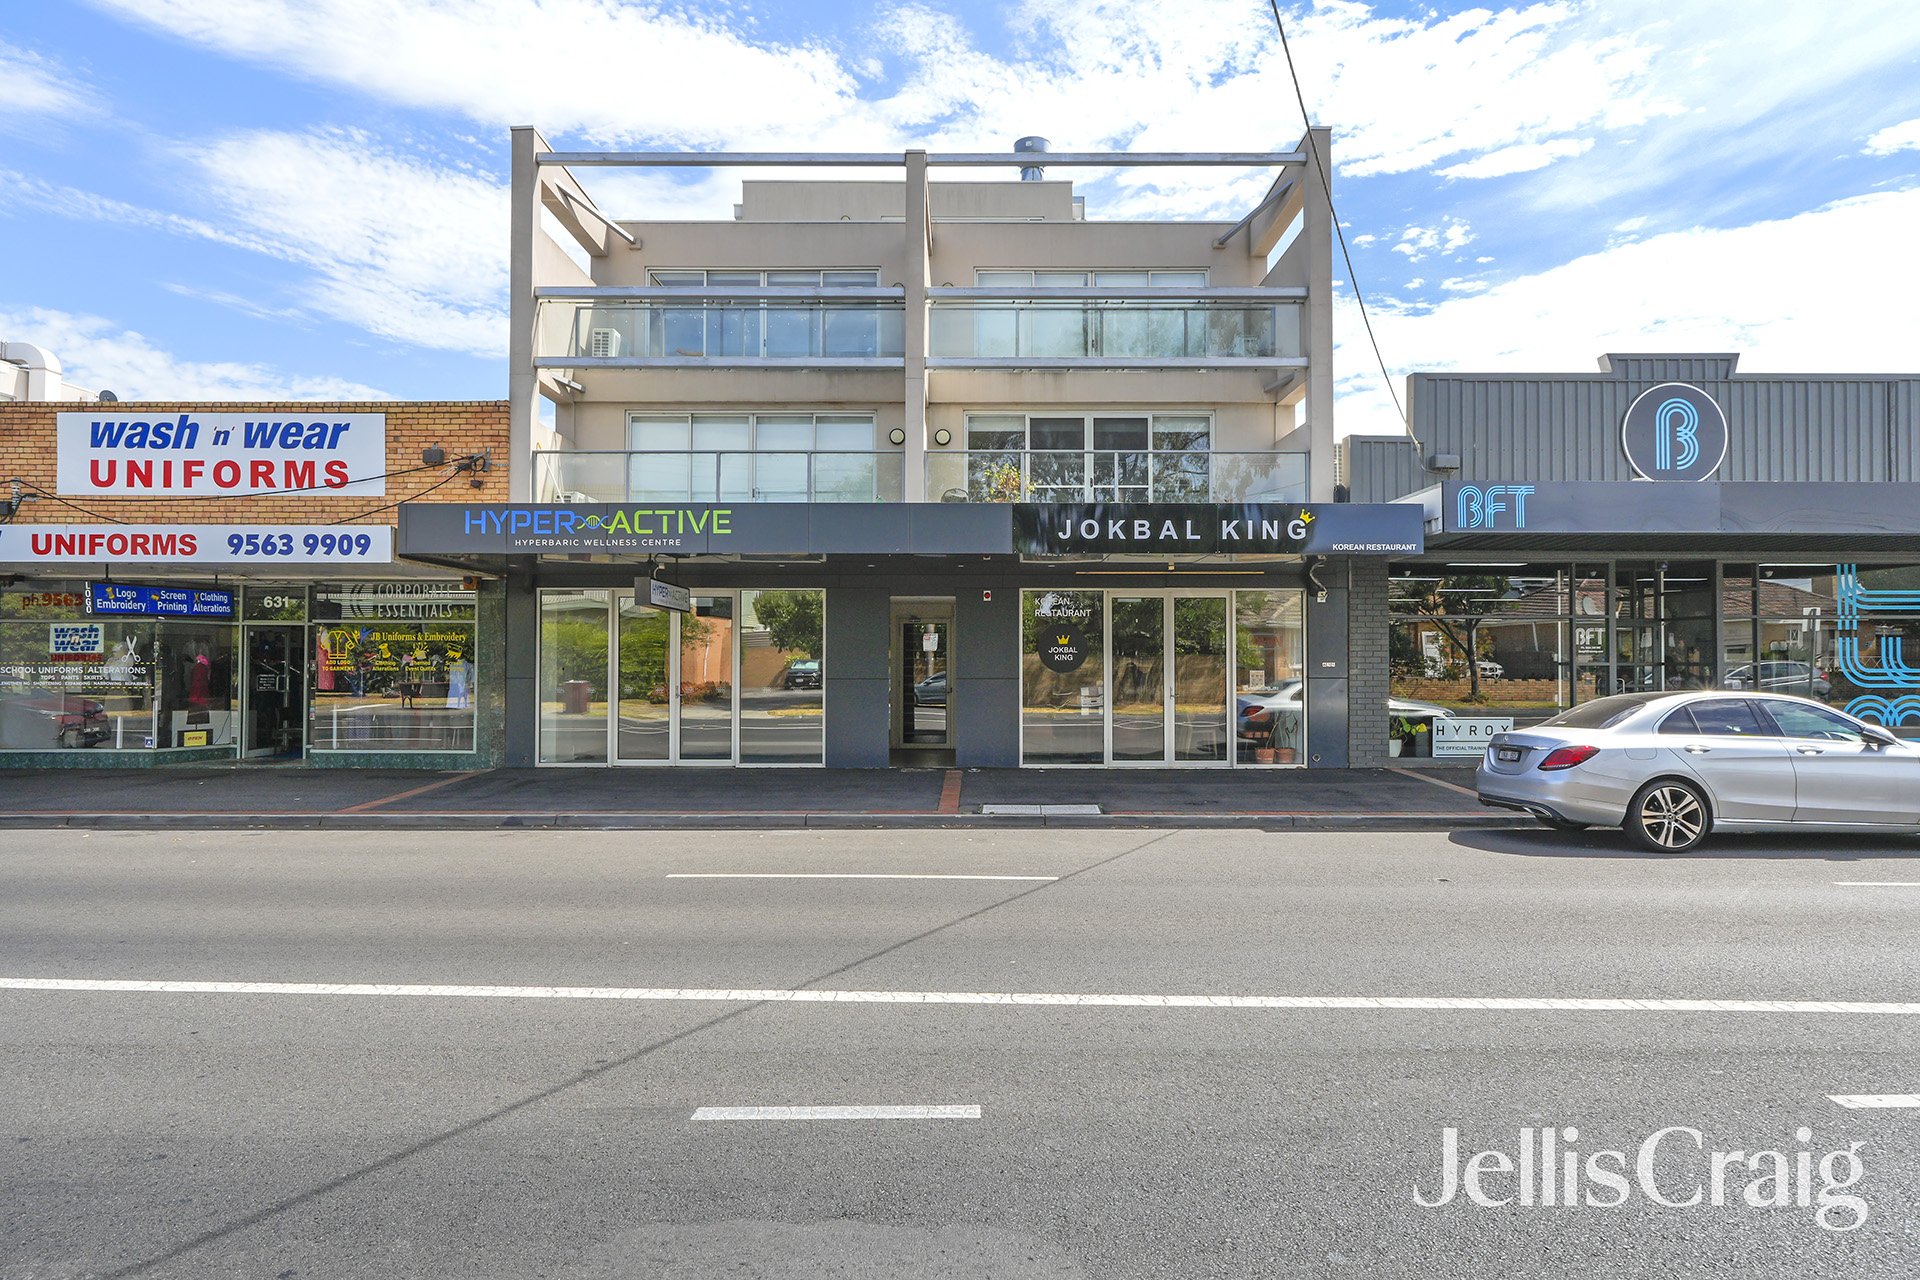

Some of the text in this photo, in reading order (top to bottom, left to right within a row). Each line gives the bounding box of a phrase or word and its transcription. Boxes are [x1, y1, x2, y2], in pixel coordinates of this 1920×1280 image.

[90, 414, 200, 450] wash
[244, 422, 350, 450] wear
[90, 459, 350, 489] UNIFORMS
[1457, 486, 1535, 529] BFT
[465, 510, 732, 535] HYPER ACTIVE
[1058, 519, 1307, 541] JOKBAL KING
[31, 534, 372, 557] UNIFORMS 9563 9909
[515, 539, 682, 547] HYPERBARIC WELLNESS CENTRE
[116, 589, 137, 600] Logo
[160, 591, 187, 601] Screen
[378, 584, 452, 598] CORPORATE
[96, 598, 146, 612] Embroidery
[200, 593, 228, 604] Clothing
[263, 597, 289, 609] 631
[1035, 597, 1070, 605] KOEAN
[157, 601, 188, 613] Printing
[193, 603, 231, 614] Alterations
[378, 604, 453, 618] ESSENTIALS
[54, 624, 99, 639] wash
[382, 632, 417, 641] Uniforms
[417, 632, 424, 641] &
[425, 632, 467, 643] Embroidery
[1575, 627, 1606, 645] BFT
[54, 640, 99, 651] wear
[0, 666, 147, 674] SCHOOL UNIFORMS ALTERATIONS
